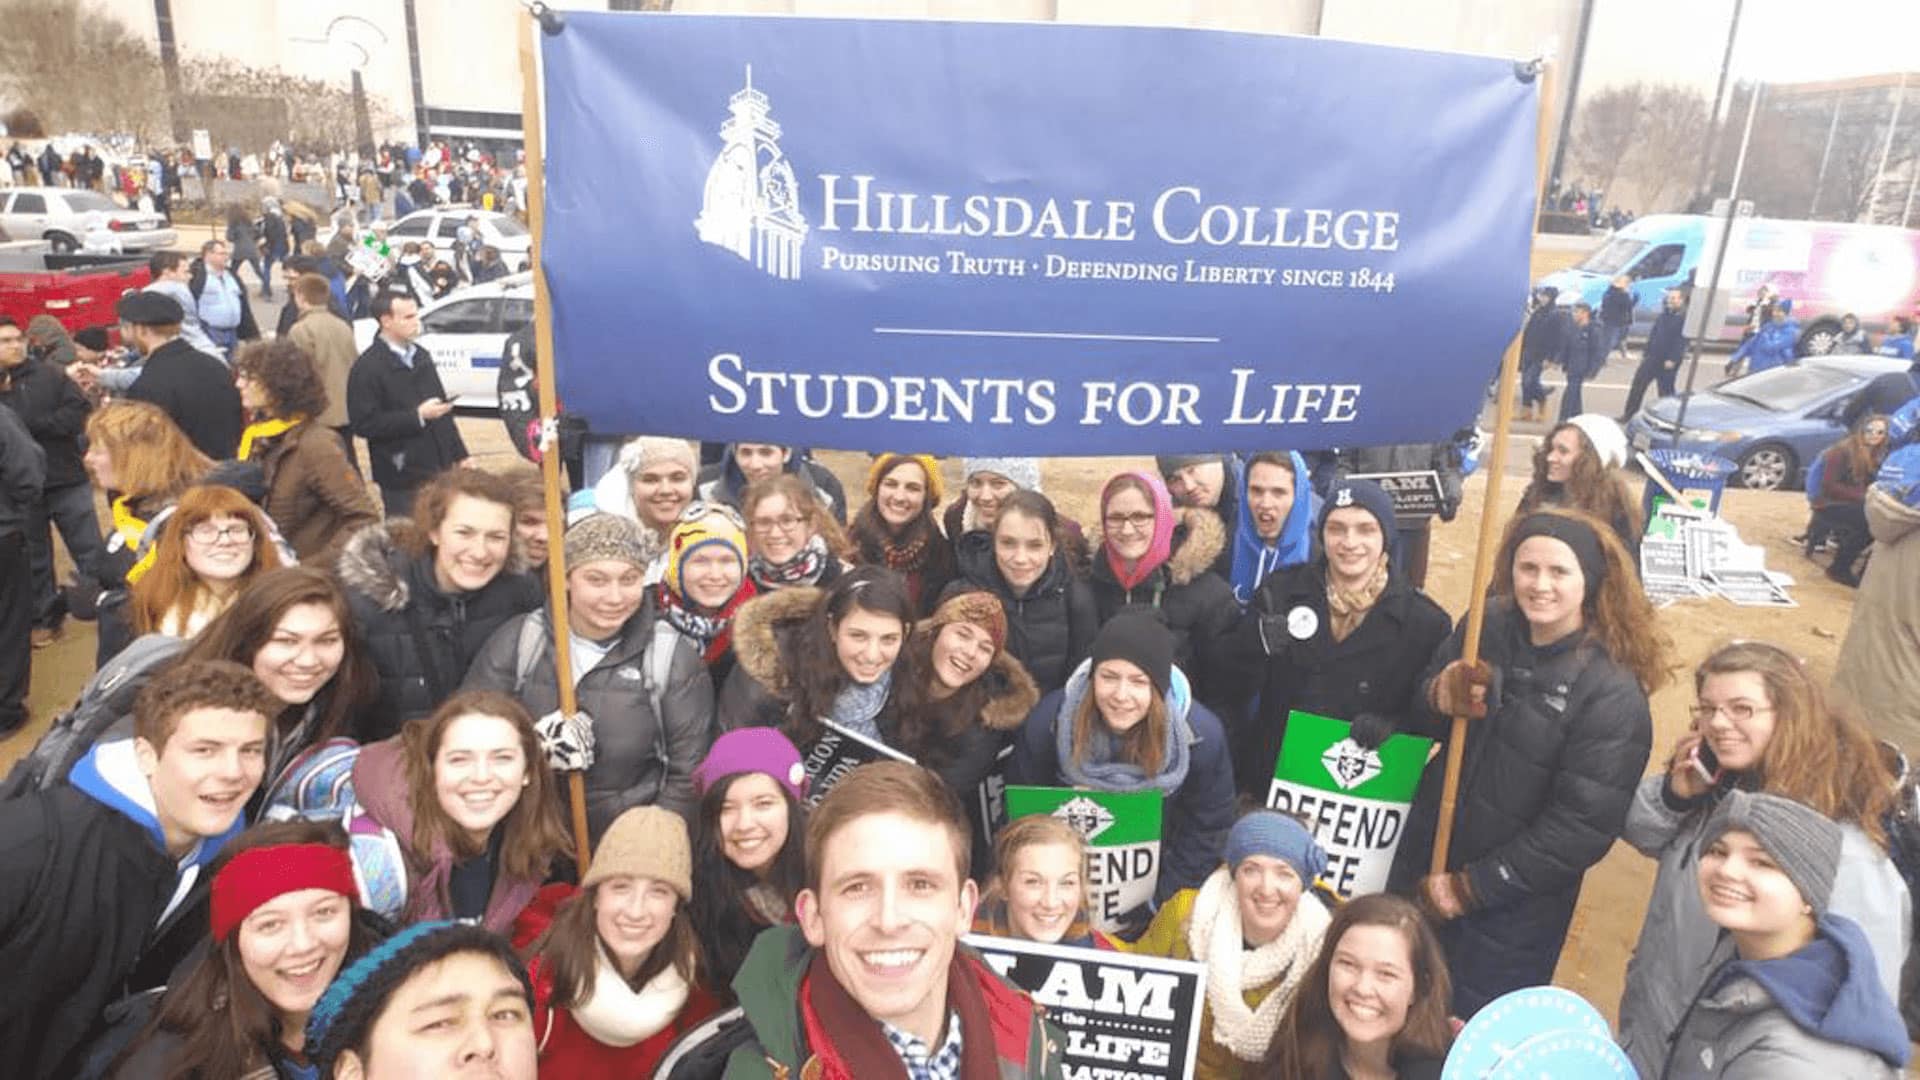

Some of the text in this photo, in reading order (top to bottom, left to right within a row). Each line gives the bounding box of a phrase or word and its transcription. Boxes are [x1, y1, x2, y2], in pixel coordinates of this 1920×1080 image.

[819, 175, 1400, 252] HILLSDALE COLLEGE
[822, 246, 940, 273] PURSUING
[946, 250, 1025, 276] TRUTH
[1045, 254, 1178, 282] DEFENDING
[1185, 259, 1276, 285] LIBERTY
[1349, 267, 1395, 293] 1844
[708, 353, 1361, 425] STUDENTS FOR LIFE
[1086, 848, 1153, 885] END
[1031, 960, 1180, 1021] AM
[1061, 1012, 1086, 1026] the
